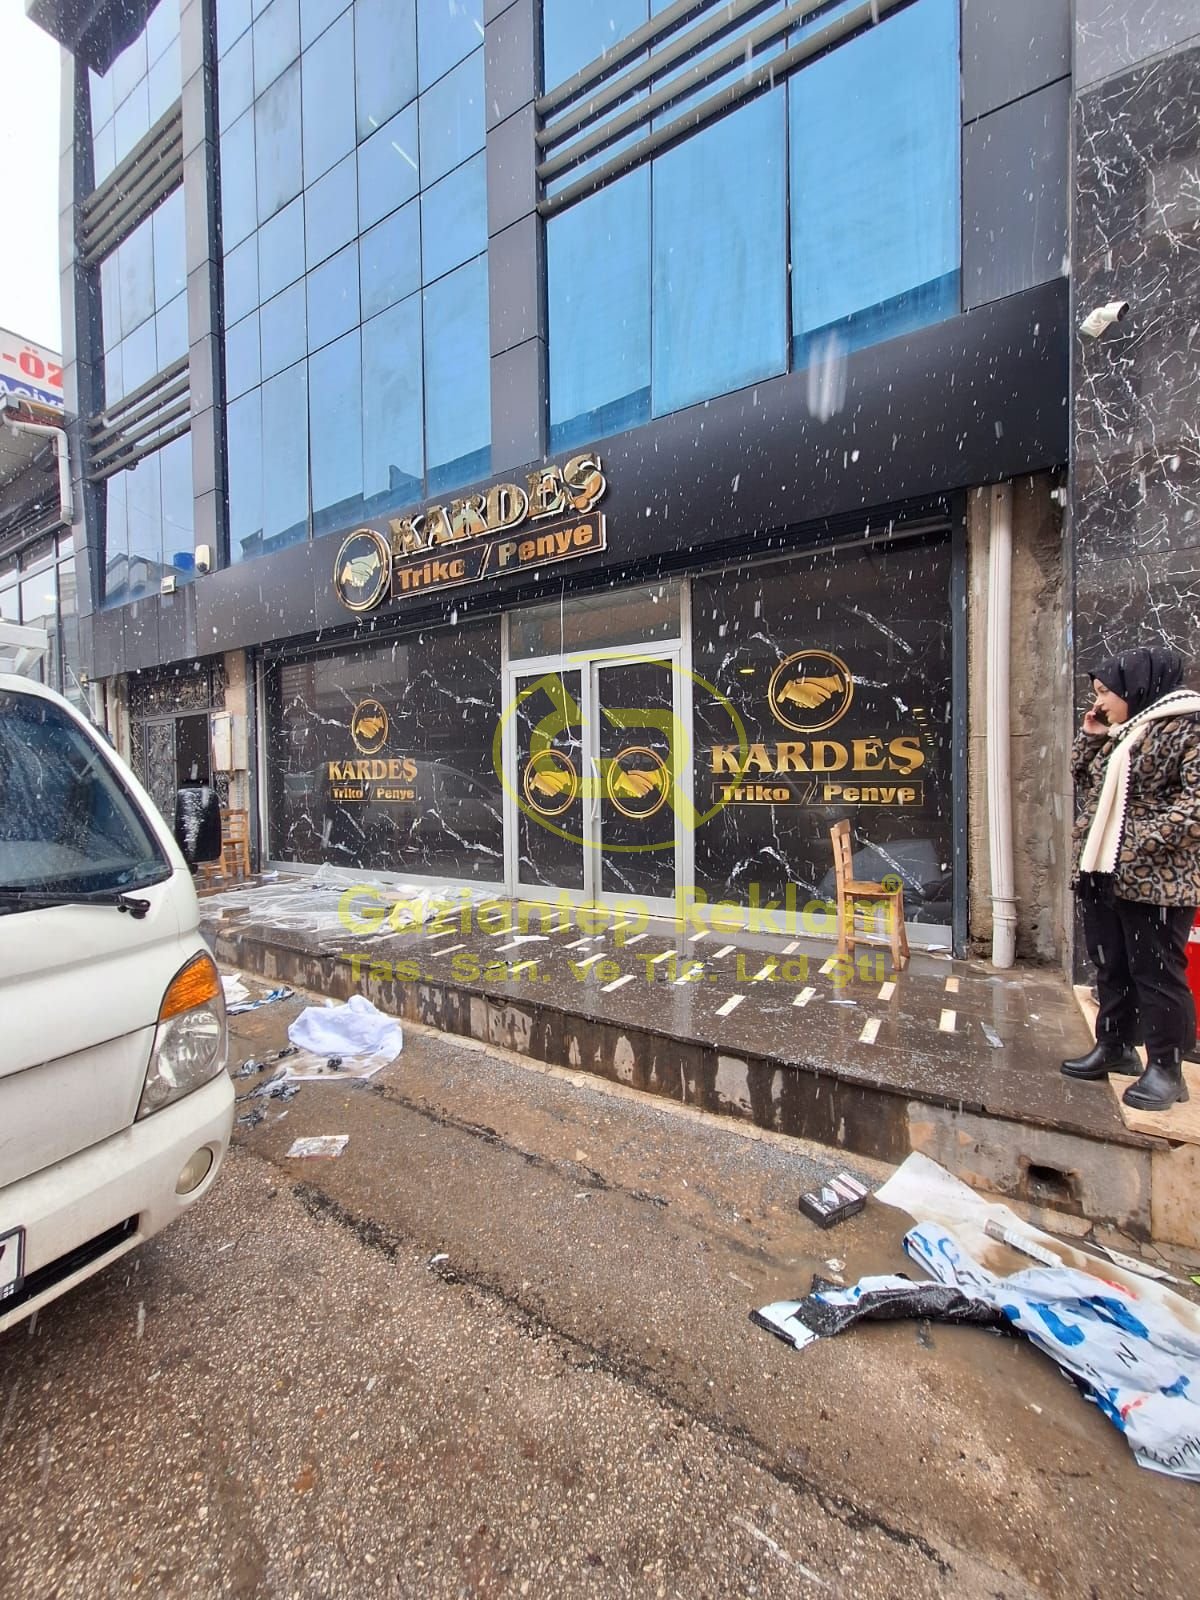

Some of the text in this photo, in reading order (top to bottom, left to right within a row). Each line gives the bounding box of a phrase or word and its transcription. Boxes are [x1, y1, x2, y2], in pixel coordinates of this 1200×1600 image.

[397, 522, 593, 591] Triko Penye
[711, 736, 925, 775] KARDEŞ
[328, 758, 418, 782] KARDEŞ
[332, 787, 415, 799] Triko Penye
[720, 784, 916, 804] Triko Penye
